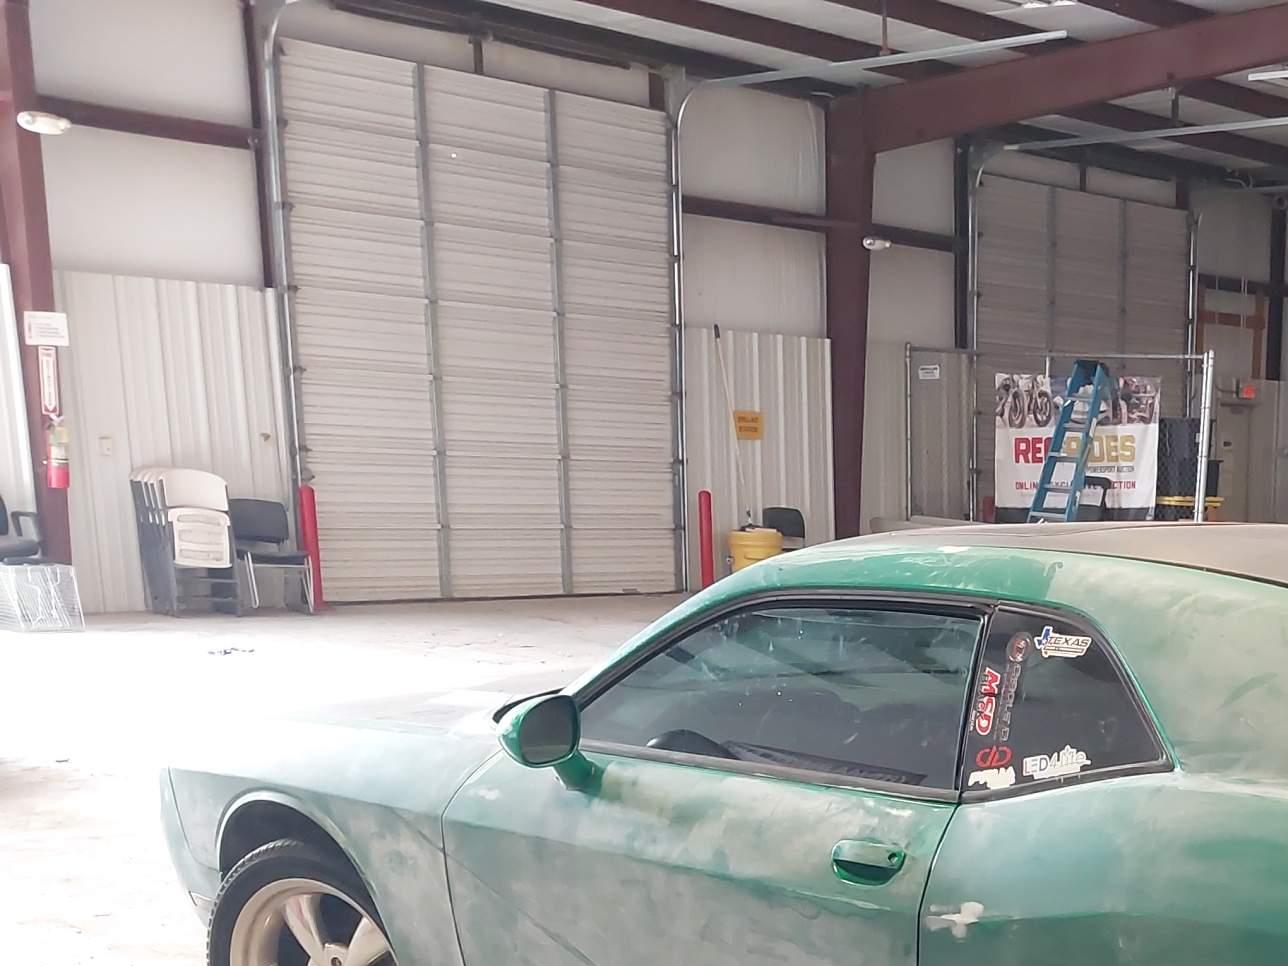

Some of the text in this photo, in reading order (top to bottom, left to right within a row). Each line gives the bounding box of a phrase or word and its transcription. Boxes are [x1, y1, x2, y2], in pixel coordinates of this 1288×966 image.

[1015, 481, 1039, 490] ONLIN
[1046, 636, 1090, 649] TEXAS
[976, 668, 1001, 735] MSD
